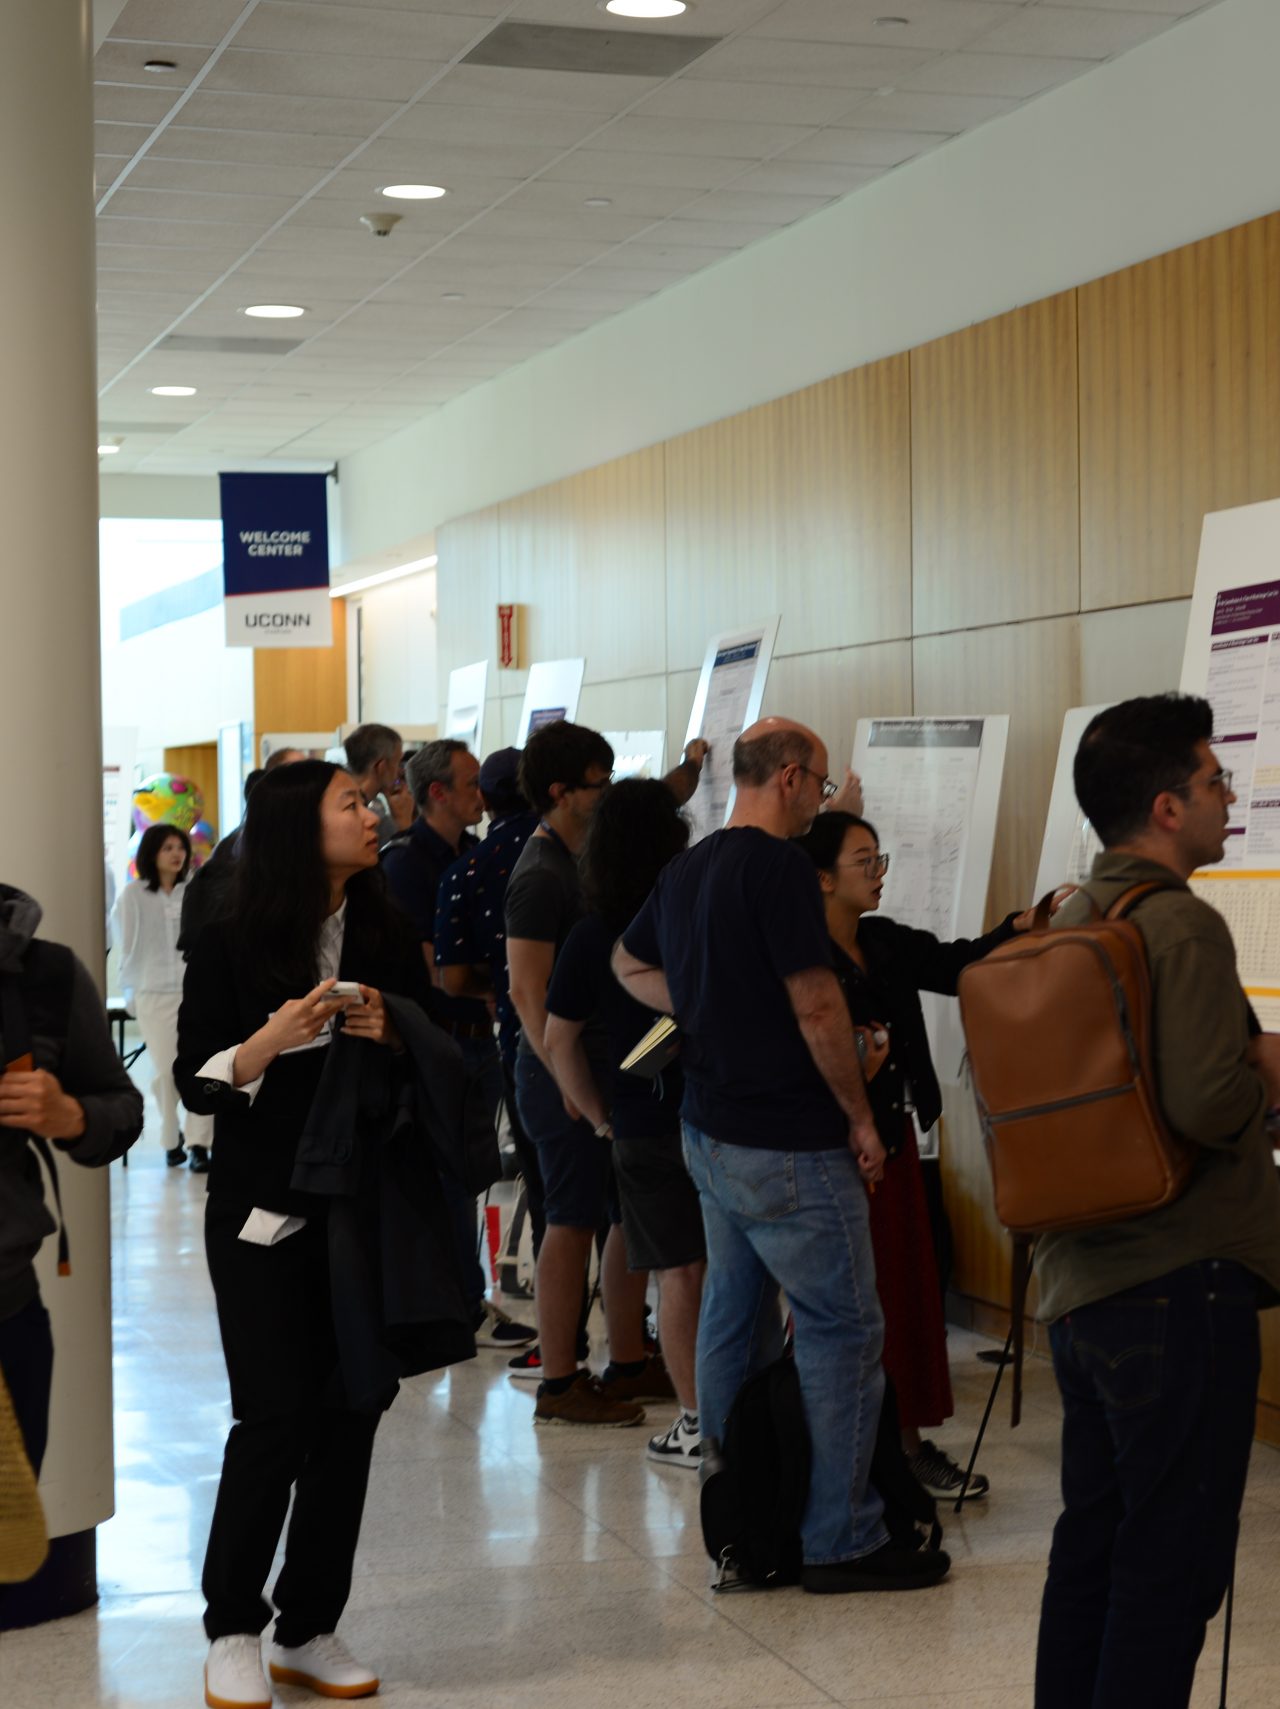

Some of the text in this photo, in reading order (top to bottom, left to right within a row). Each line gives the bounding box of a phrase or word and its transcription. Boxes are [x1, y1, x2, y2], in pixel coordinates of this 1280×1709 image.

[239, 530, 311, 543] WELCOME
[248, 544, 303, 557] CENTER
[245, 612, 311, 628] UCONN
